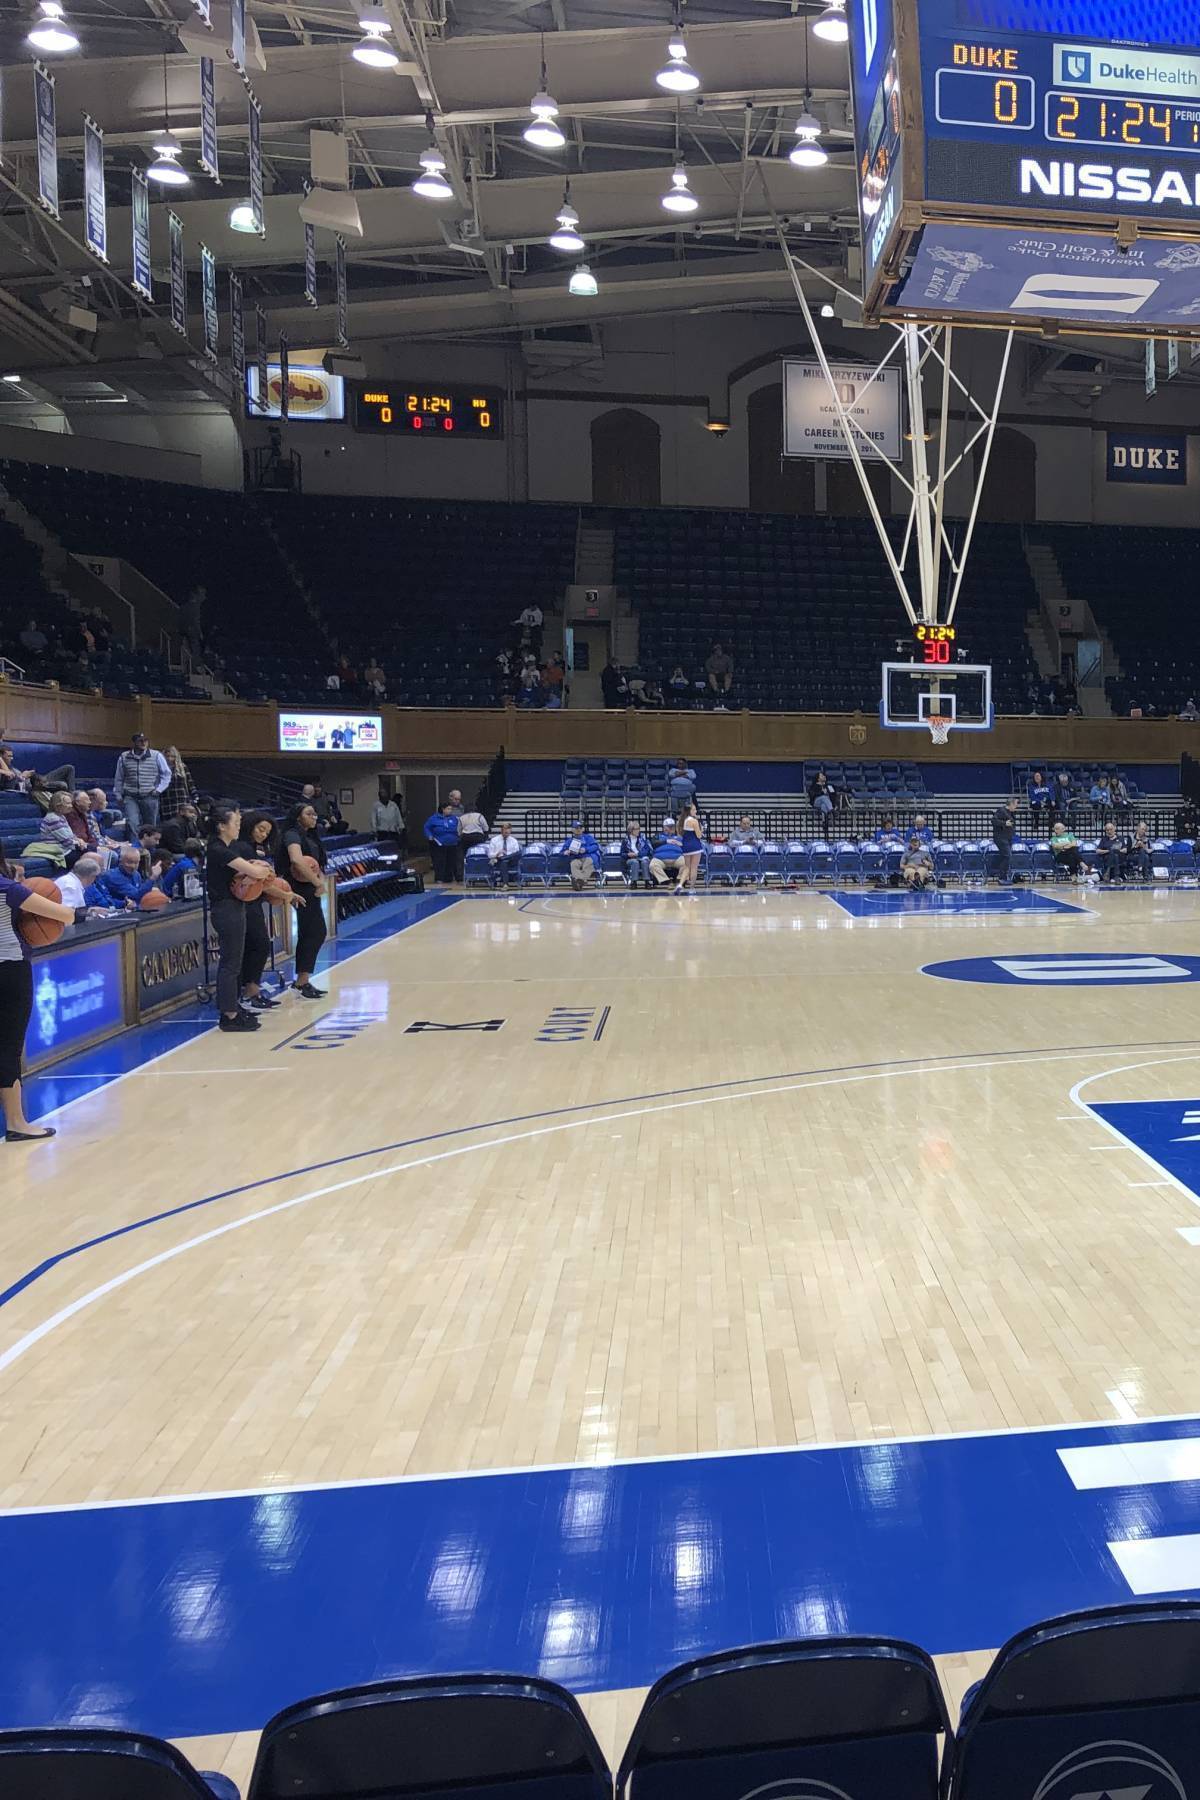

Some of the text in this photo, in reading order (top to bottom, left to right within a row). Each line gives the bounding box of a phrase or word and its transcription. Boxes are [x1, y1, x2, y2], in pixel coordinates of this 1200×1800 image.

[954, 44, 1018, 69] DUKE
[1100, 63, 1198, 85] DukeHealth
[995, 80, 1017, 122] 0
[1057, 96, 1170, 143] 21:24
[1018, 240, 1056, 250] Club
[1060, 244, 1097, 256] Golf
[1008, 246, 1145, 266] Washington Duke
[364, 394, 388, 403] DUKE
[408, 396, 450, 412] 21:24
[381, 408, 391, 422] 0
[481, 412, 490, 427] 0
[804, 428, 838, 438] CAREER
[1113, 446, 1179, 470] DUKE
[917, 626, 955, 640] 21:24
[924, 640, 950, 663] 30
[142, 939, 200, 988] CAMERON
